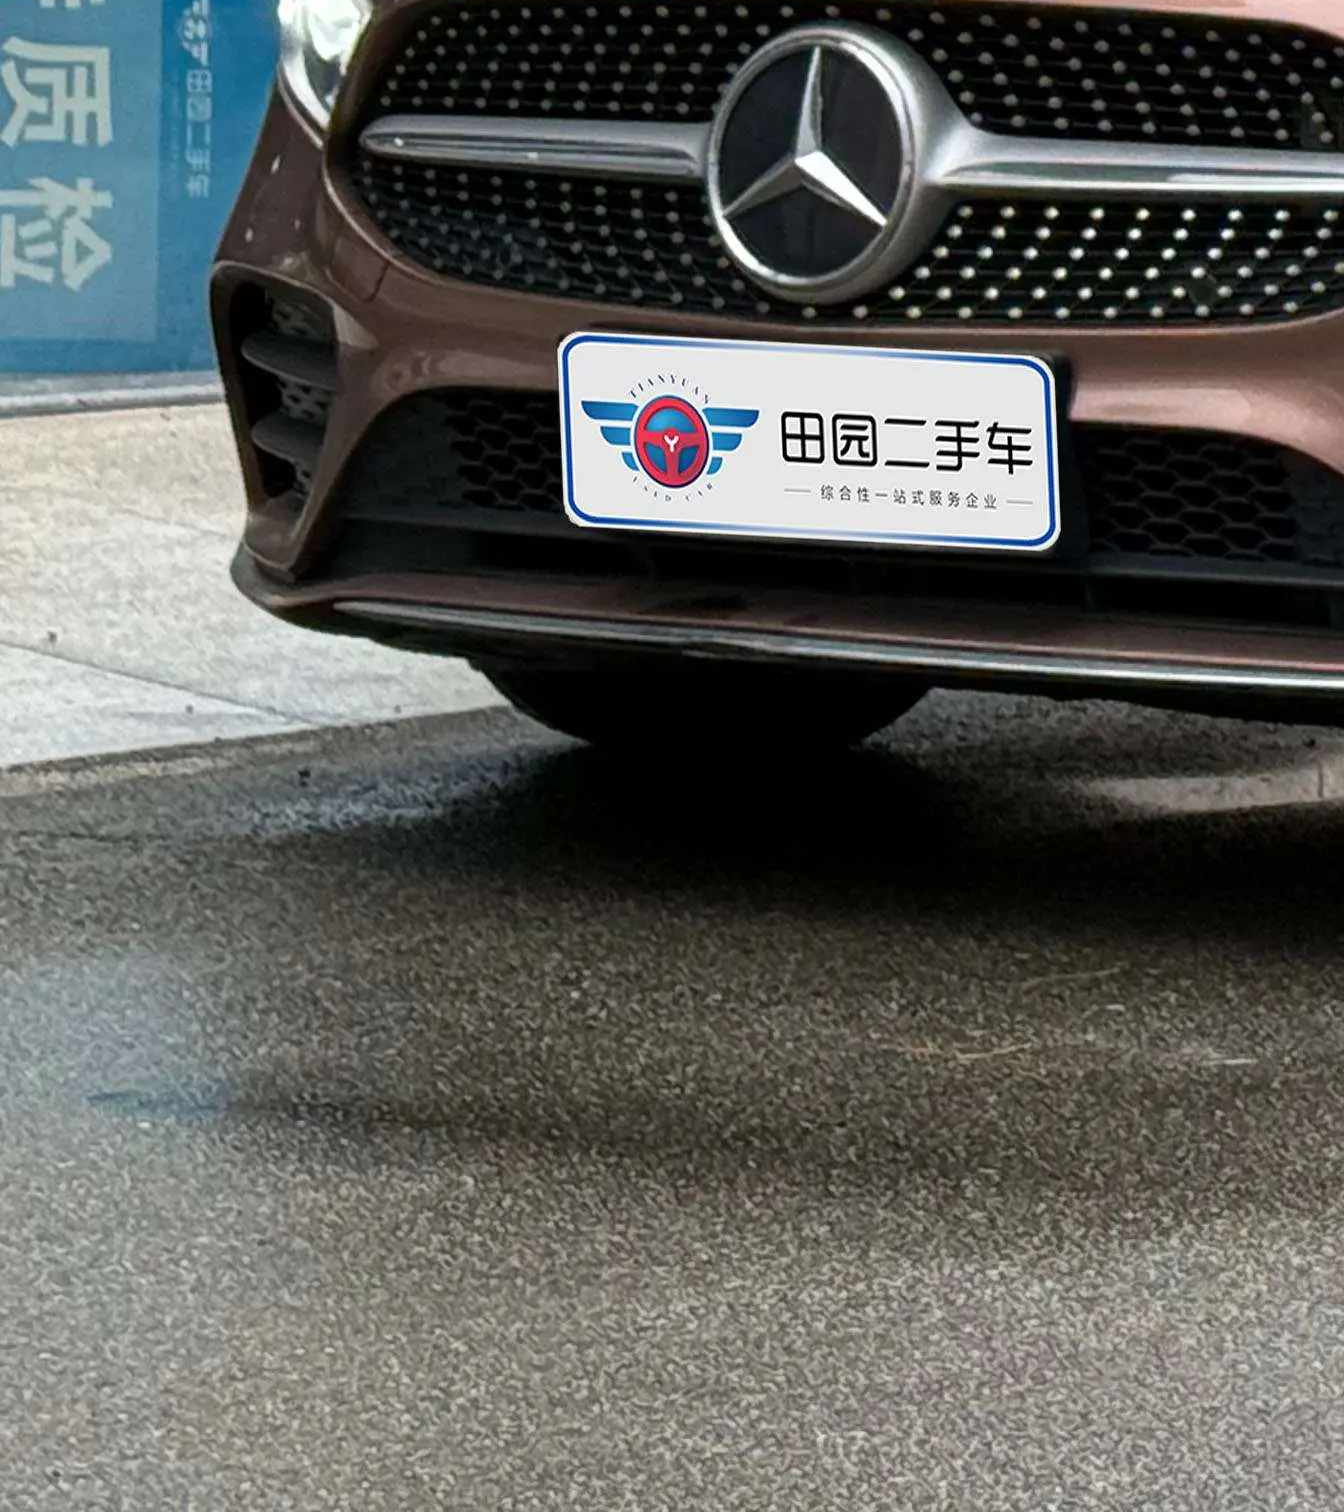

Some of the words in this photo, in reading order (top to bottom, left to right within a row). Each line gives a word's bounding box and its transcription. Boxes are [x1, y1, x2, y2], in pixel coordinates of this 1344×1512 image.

[781, 411, 1034, 475] 田园二手车
[820, 484, 998, 509] 综合性一站式服务企业
